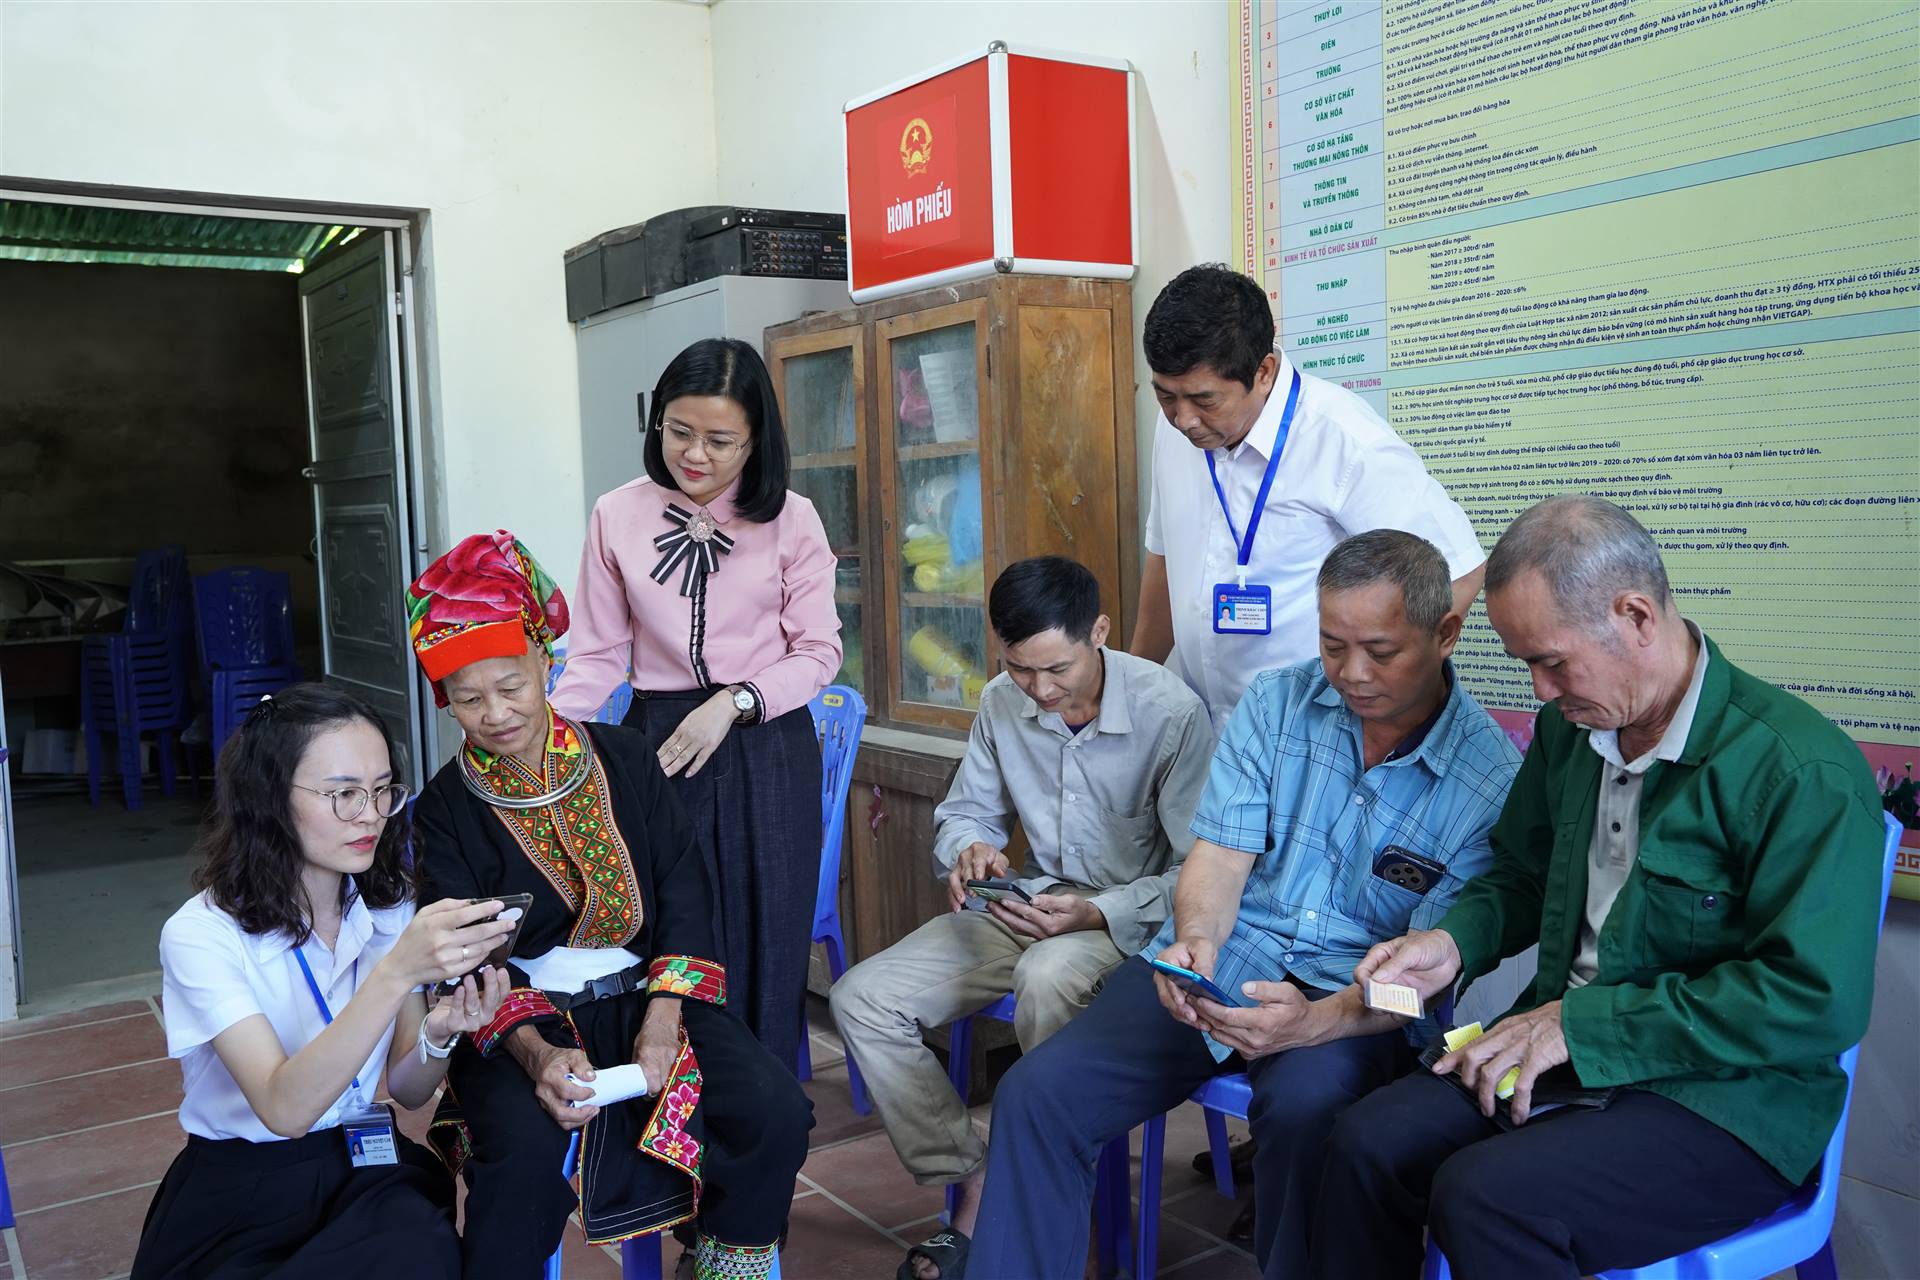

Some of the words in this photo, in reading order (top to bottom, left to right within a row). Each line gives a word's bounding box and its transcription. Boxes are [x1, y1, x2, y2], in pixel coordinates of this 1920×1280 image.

[1320, 38, 1336, 51] ĐIỆN
[1315, 63, 1341, 79] TRƯỜNG
[1313, 178, 1335, 191] THÔNG
[1336, 175, 1347, 186] TIN
[887, 197, 913, 233] HÒM
[916, 182, 952, 225] PHIẾU
[1817, 277, 1835, 287] HTX
[1835, 274, 1856, 286] phải
[1856, 273, 1867, 282] có
[1868, 270, 1881, 280] tối
[1882, 267, 1906, 278] thiểu
[1316, 281, 1329, 291] THU
[1330, 278, 1347, 288] NHẬP
[1316, 315, 1326, 326] HỘ
[1326, 312, 1348, 324] NGHÈO
[1302, 359, 1318, 369] HÌNH
[1318, 357, 1335, 367] THỨC
[1337, 353, 1346, 365] TỔ
[1346, 352, 1365, 364] CHỨC
[1733, 451, 1743, 459] 03
[1744, 450, 1762, 458] năm
[1762, 449, 1778, 457] liên
[1778, 449, 1791, 457] tục
[1792, 447, 1805, 455] trở
[1658, 527, 1675, 535] cảnh
[1695, 526, 1705, 534] và
[1705, 526, 1720, 534] môi
[1720, 526, 1747, 535] trường
[1663, 542, 1681, 551] được
[1681, 541, 1695, 549] thu
[1695, 543, 1714, 551] gom,
[1715, 541, 1725, 549] xử
[1725, 541, 1733, 550] lý
[1733, 541, 1752, 549] theo
[1768, 541, 1789, 550] định.
[1674, 586, 1692, 594] toàn
[1692, 586, 1709, 595] thực
[1709, 586, 1731, 596] phẩm
[1786, 682, 1801, 690] của
[1802, 683, 1815, 693] gia
[1816, 684, 1835, 692] đình
[1847, 686, 1862, 694] đời
[1863, 687, 1885, 698] sống
[1886, 689, 1897, 697] xã
[1898, 689, 1916, 699] hội.
[1840, 718, 1852, 727] tội
[1853, 719, 1878, 729] phạm
[1879, 721, 1890, 729] và
[1892, 722, 1901, 732] tệ
